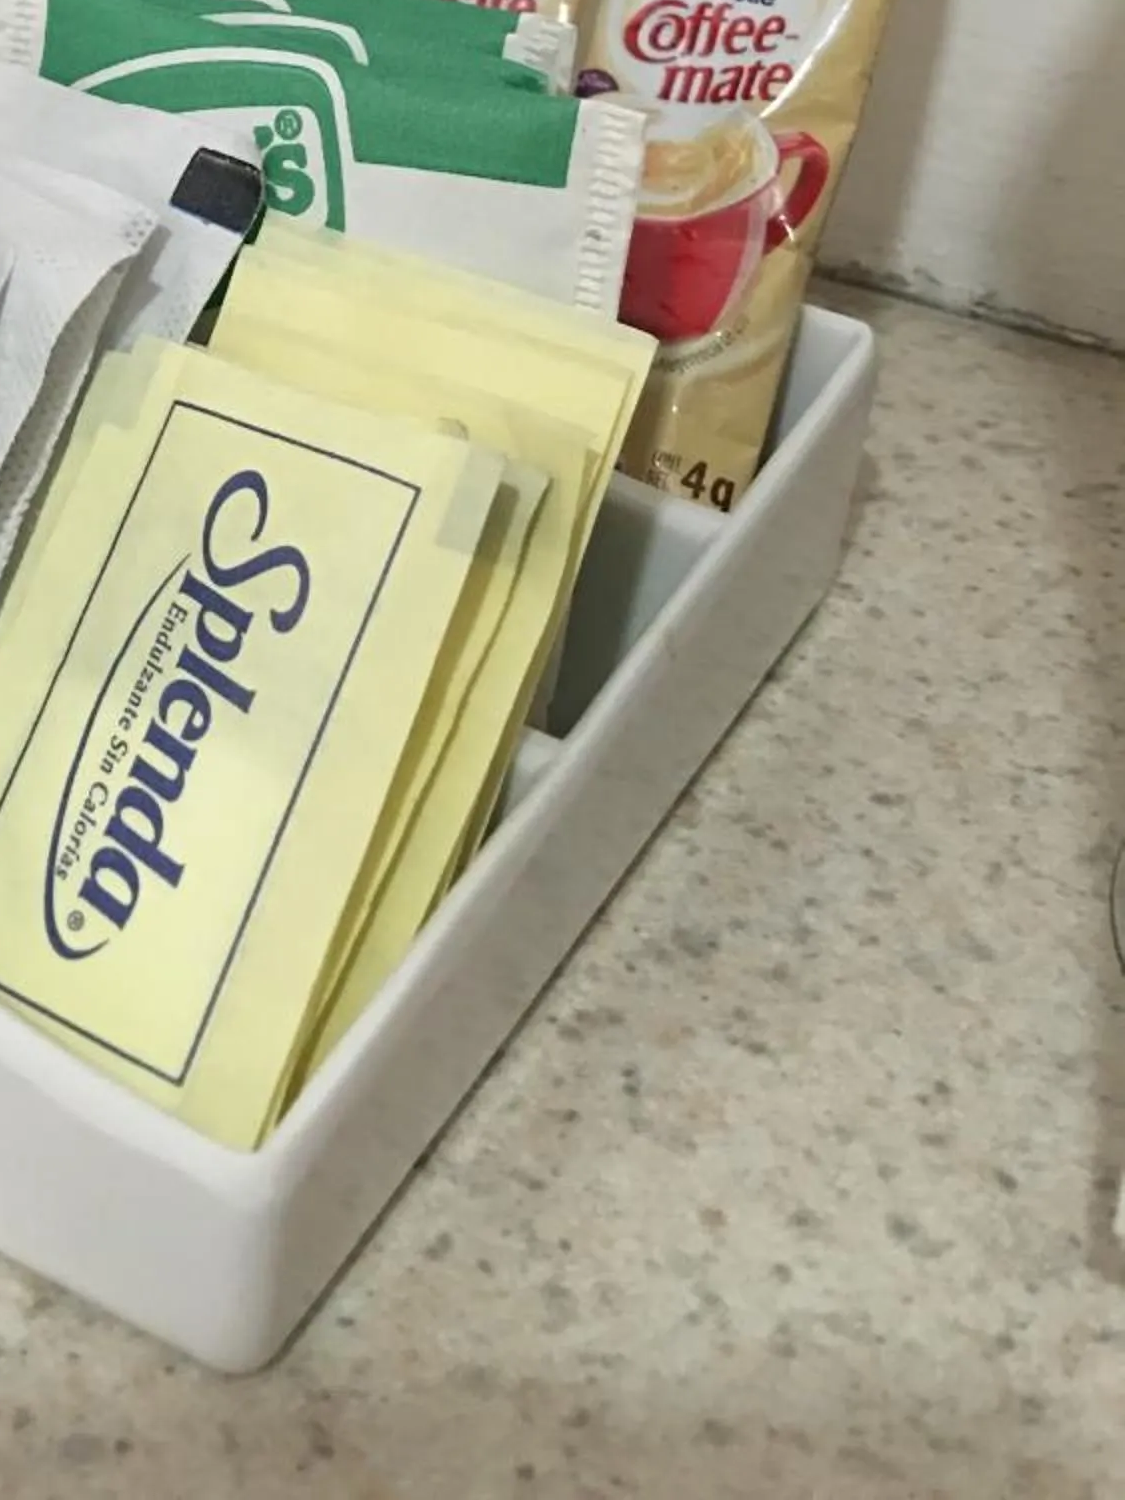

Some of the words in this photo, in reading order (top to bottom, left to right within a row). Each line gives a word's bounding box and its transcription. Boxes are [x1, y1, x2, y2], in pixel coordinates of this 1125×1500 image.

[656, 59, 796, 104] mate
[118, 600, 188, 731] Endulzante
[99, 734, 129, 775] Sin
